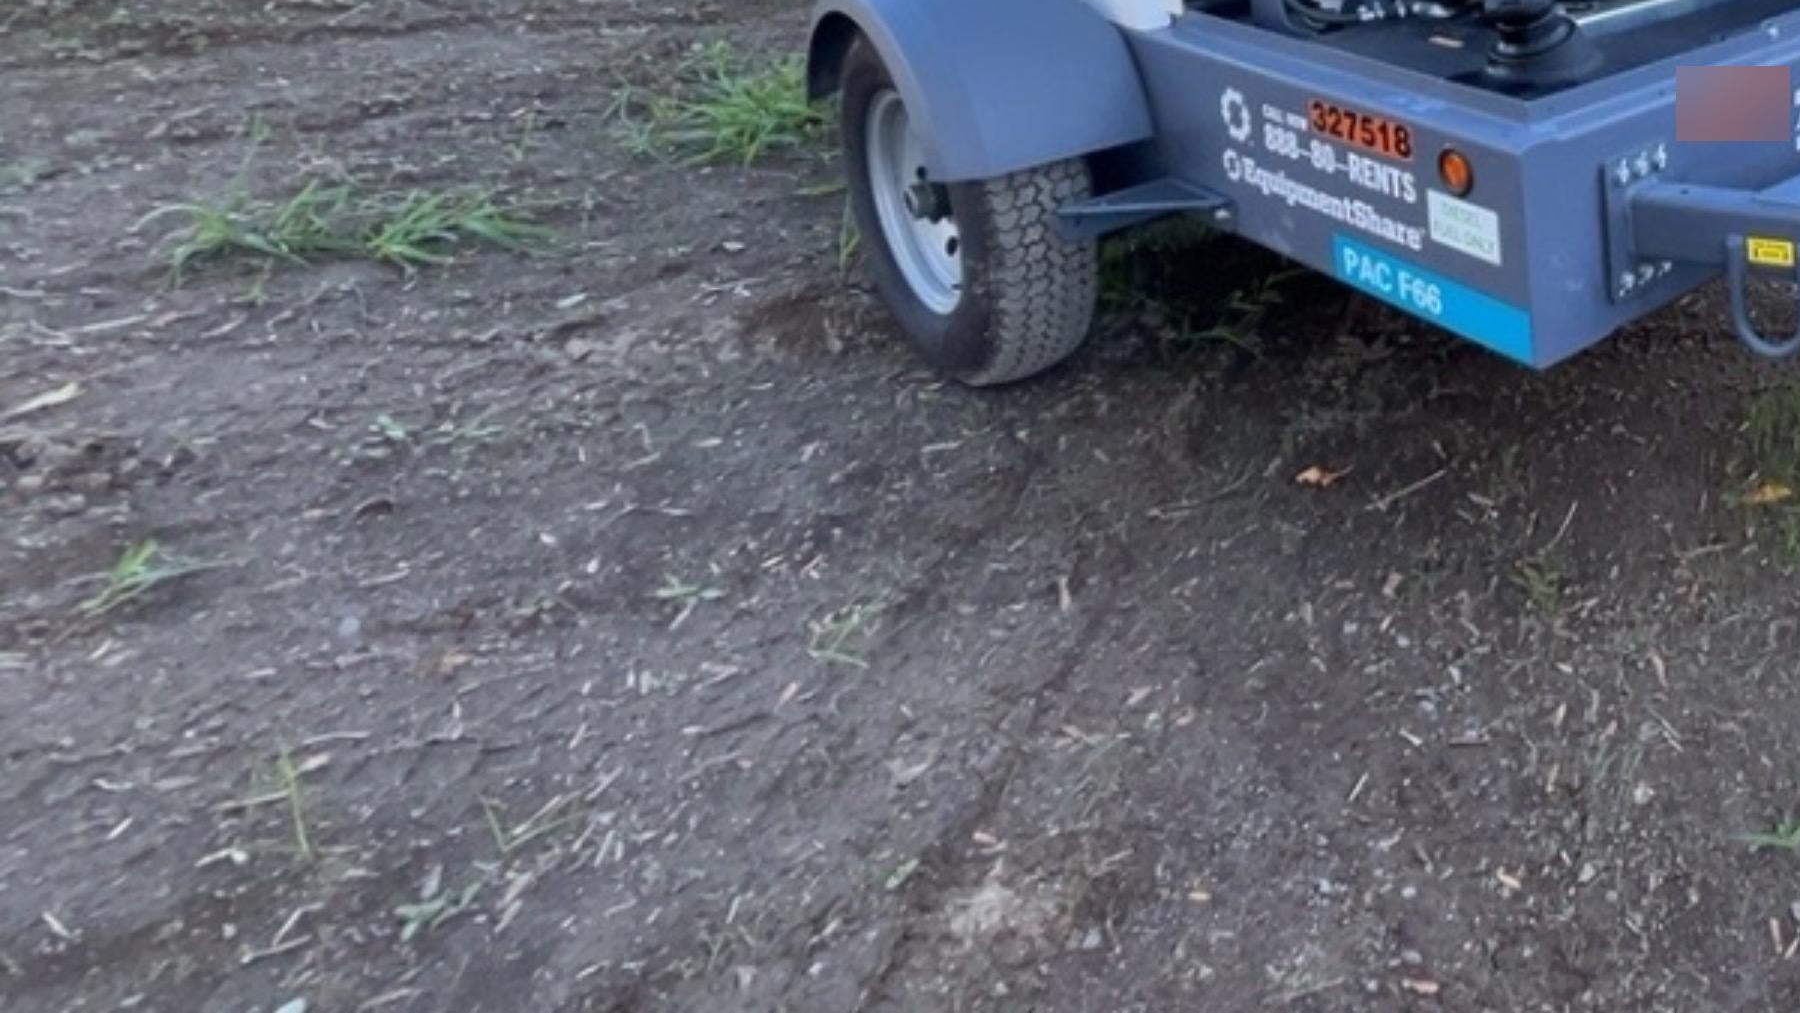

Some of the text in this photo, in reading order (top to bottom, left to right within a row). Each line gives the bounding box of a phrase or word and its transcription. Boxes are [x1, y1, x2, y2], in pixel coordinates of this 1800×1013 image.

[1263, 123, 1417, 204] 888-80-RENTS
[1311, 101, 1412, 158] 327518
[1241, 156, 1423, 251] EquipmentShare
[1343, 246, 1443, 316] PAC F66
